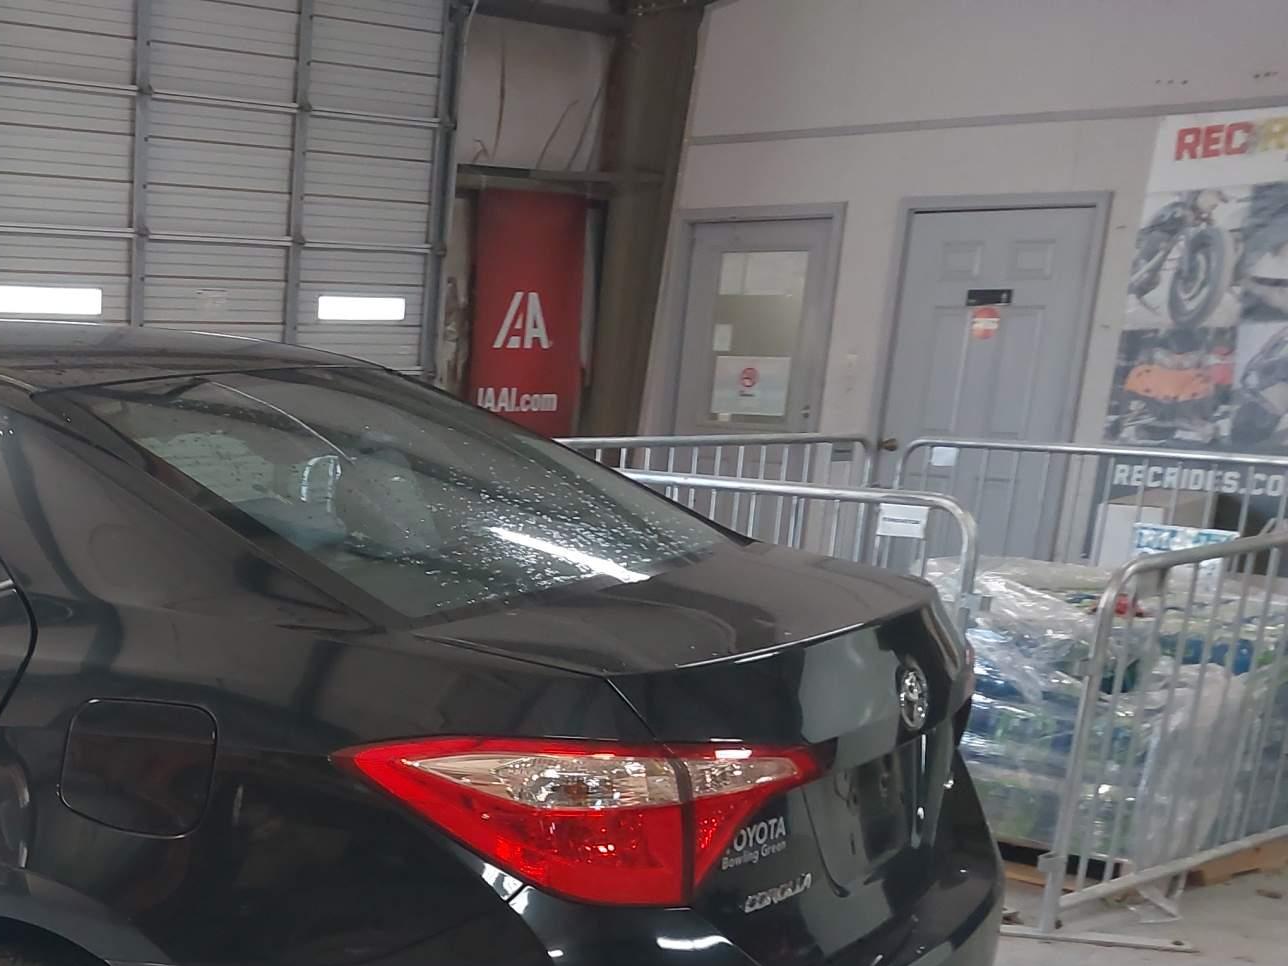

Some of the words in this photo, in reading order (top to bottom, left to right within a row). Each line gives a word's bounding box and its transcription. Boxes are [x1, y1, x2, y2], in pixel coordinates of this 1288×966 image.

[477, 387, 558, 413] IAAI.com
[726, 816, 787, 854] OYOTA
[722, 850, 759, 870] Bowling
[760, 840, 787, 857] Green
